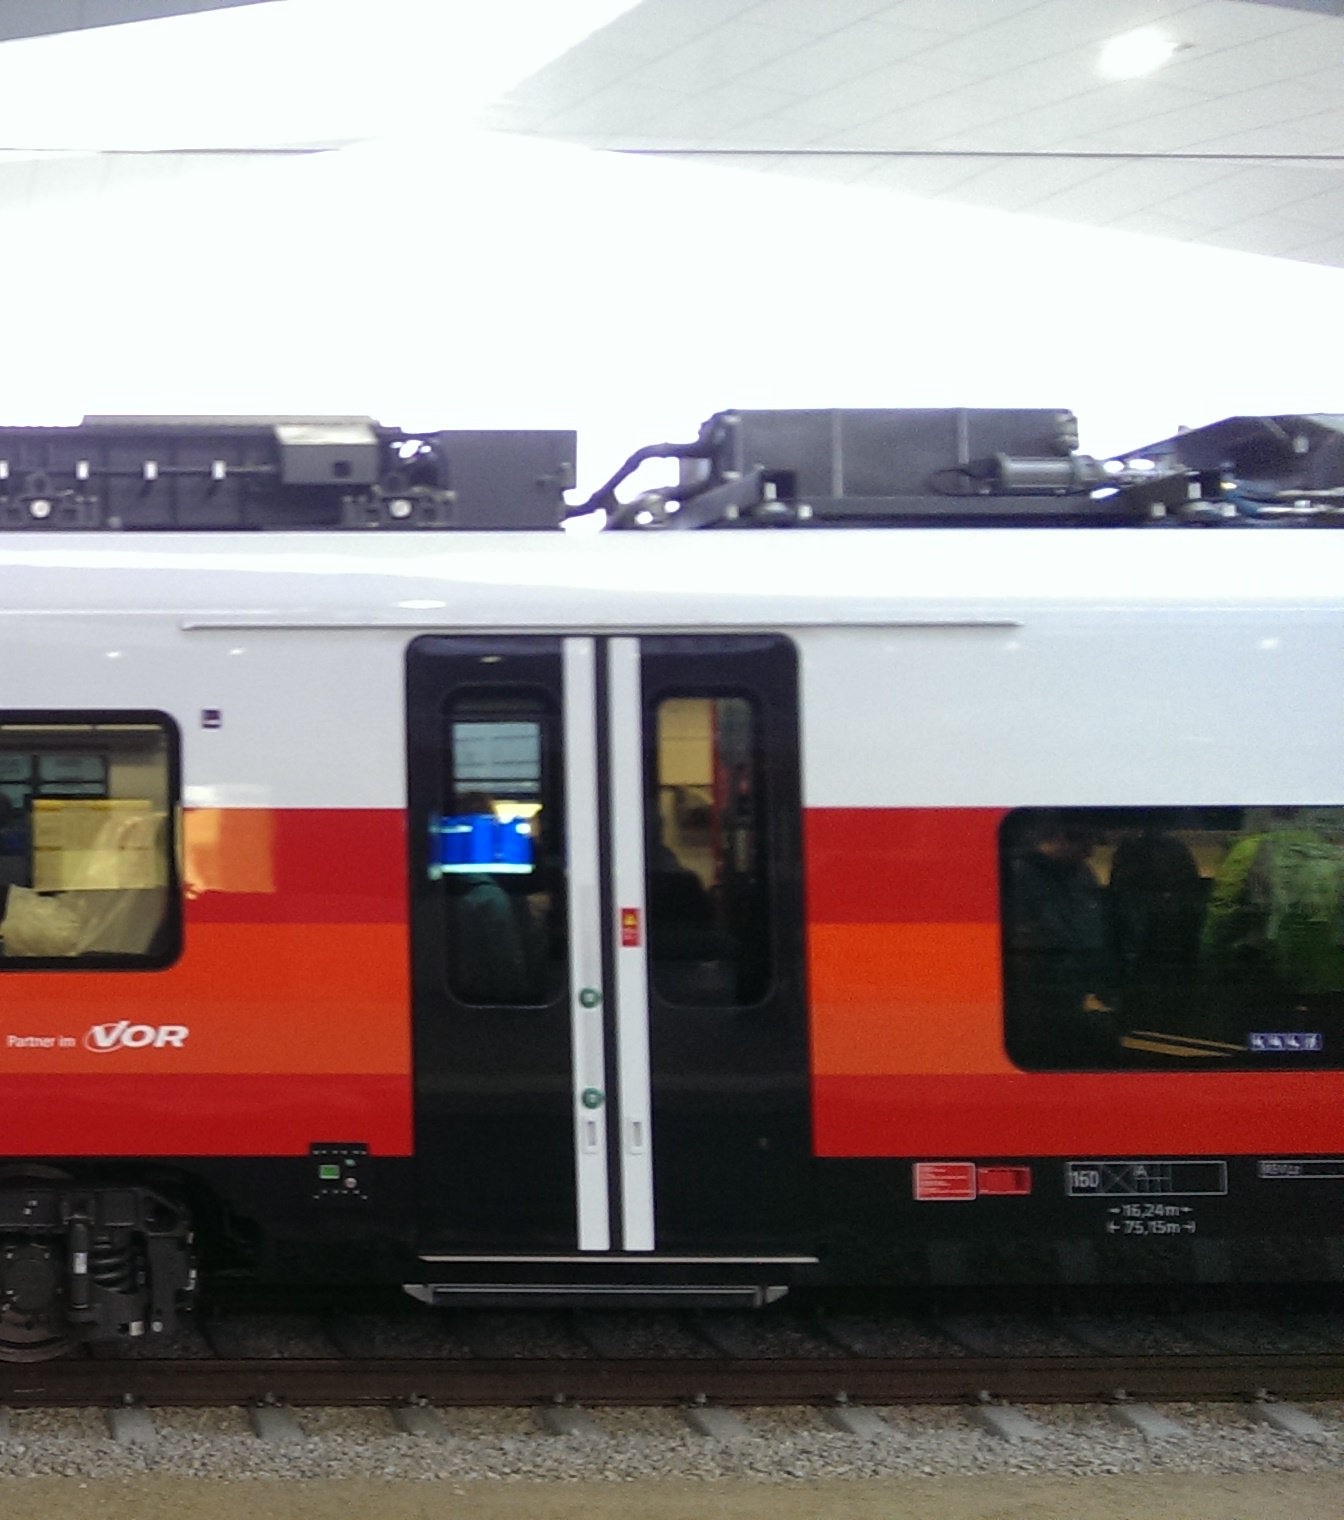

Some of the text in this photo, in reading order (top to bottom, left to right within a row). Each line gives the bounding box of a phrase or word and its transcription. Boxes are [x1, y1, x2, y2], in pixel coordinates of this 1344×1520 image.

[7, 1020, 190, 1048] Partner im VOR
